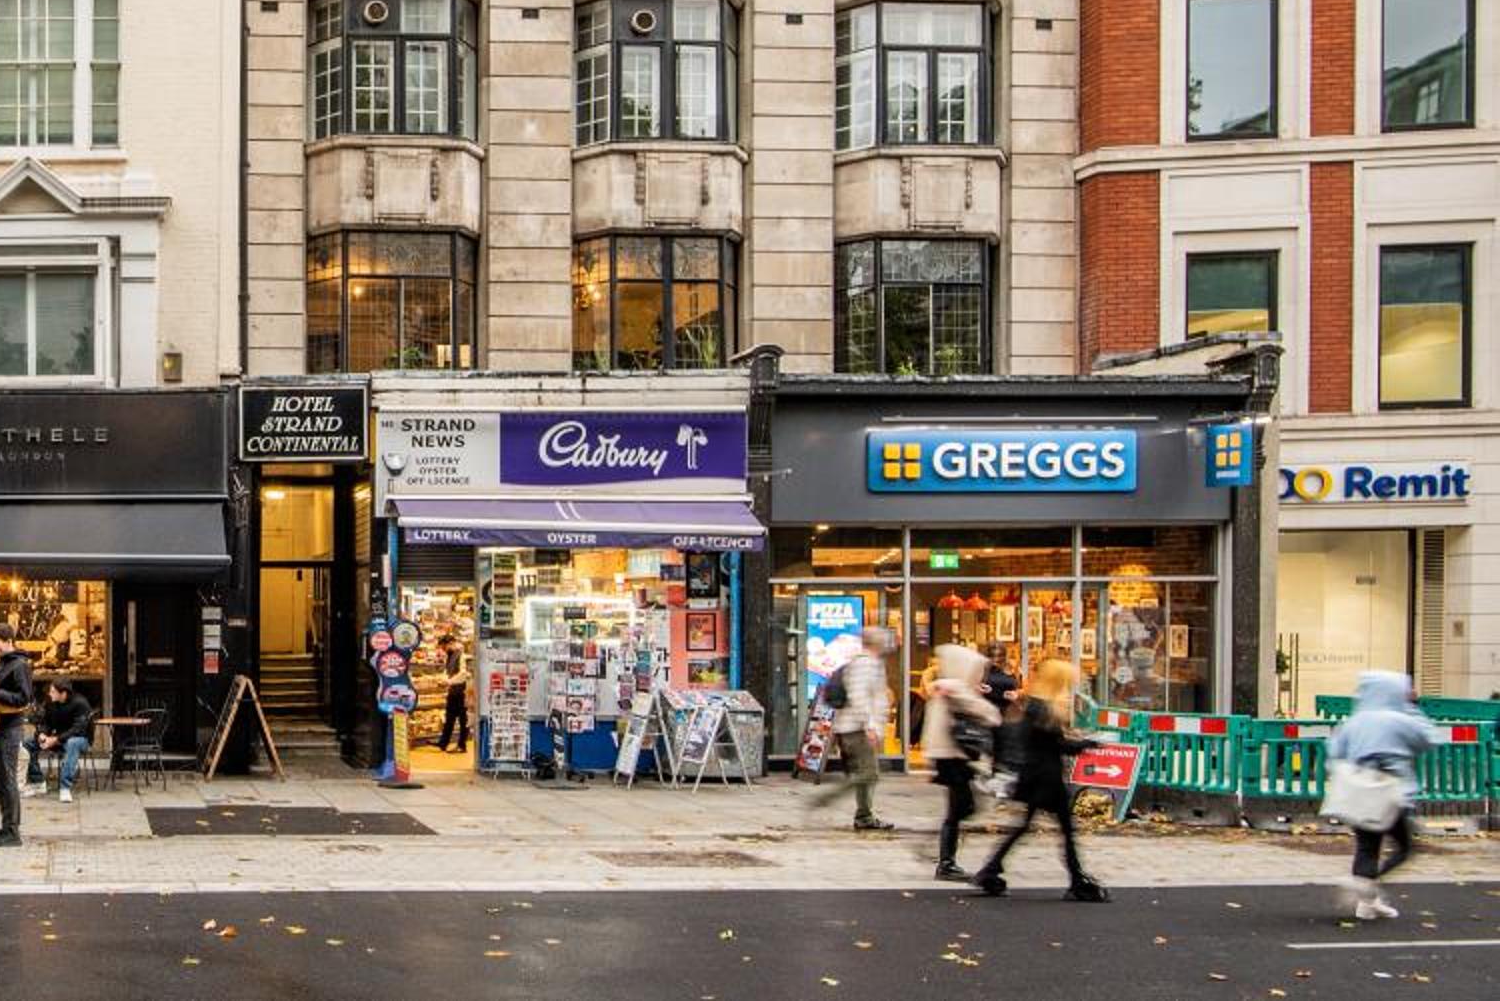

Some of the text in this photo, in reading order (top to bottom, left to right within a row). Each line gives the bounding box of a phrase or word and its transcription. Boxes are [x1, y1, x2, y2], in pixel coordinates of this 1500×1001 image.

[271, 396, 335, 412] HOTEL
[261, 416, 343, 433] STRAND
[401, 419, 476, 432] STRAND
[246, 436, 360, 452] CONTINENTAL
[411, 435, 465, 448] NEWS
[538, 420, 669, 477] Cadbury
[415, 456, 461, 466] LOTTERY
[932, 442, 1126, 478] GREGGS
[419, 467, 457, 476] OYSTER
[428, 477, 470, 486] LICENCE
[1344, 464, 1471, 499] Remit
[414, 529, 471, 541] LOTTERY
[547, 532, 597, 544] OYSTER
[811, 602, 854, 620] PIZZA
